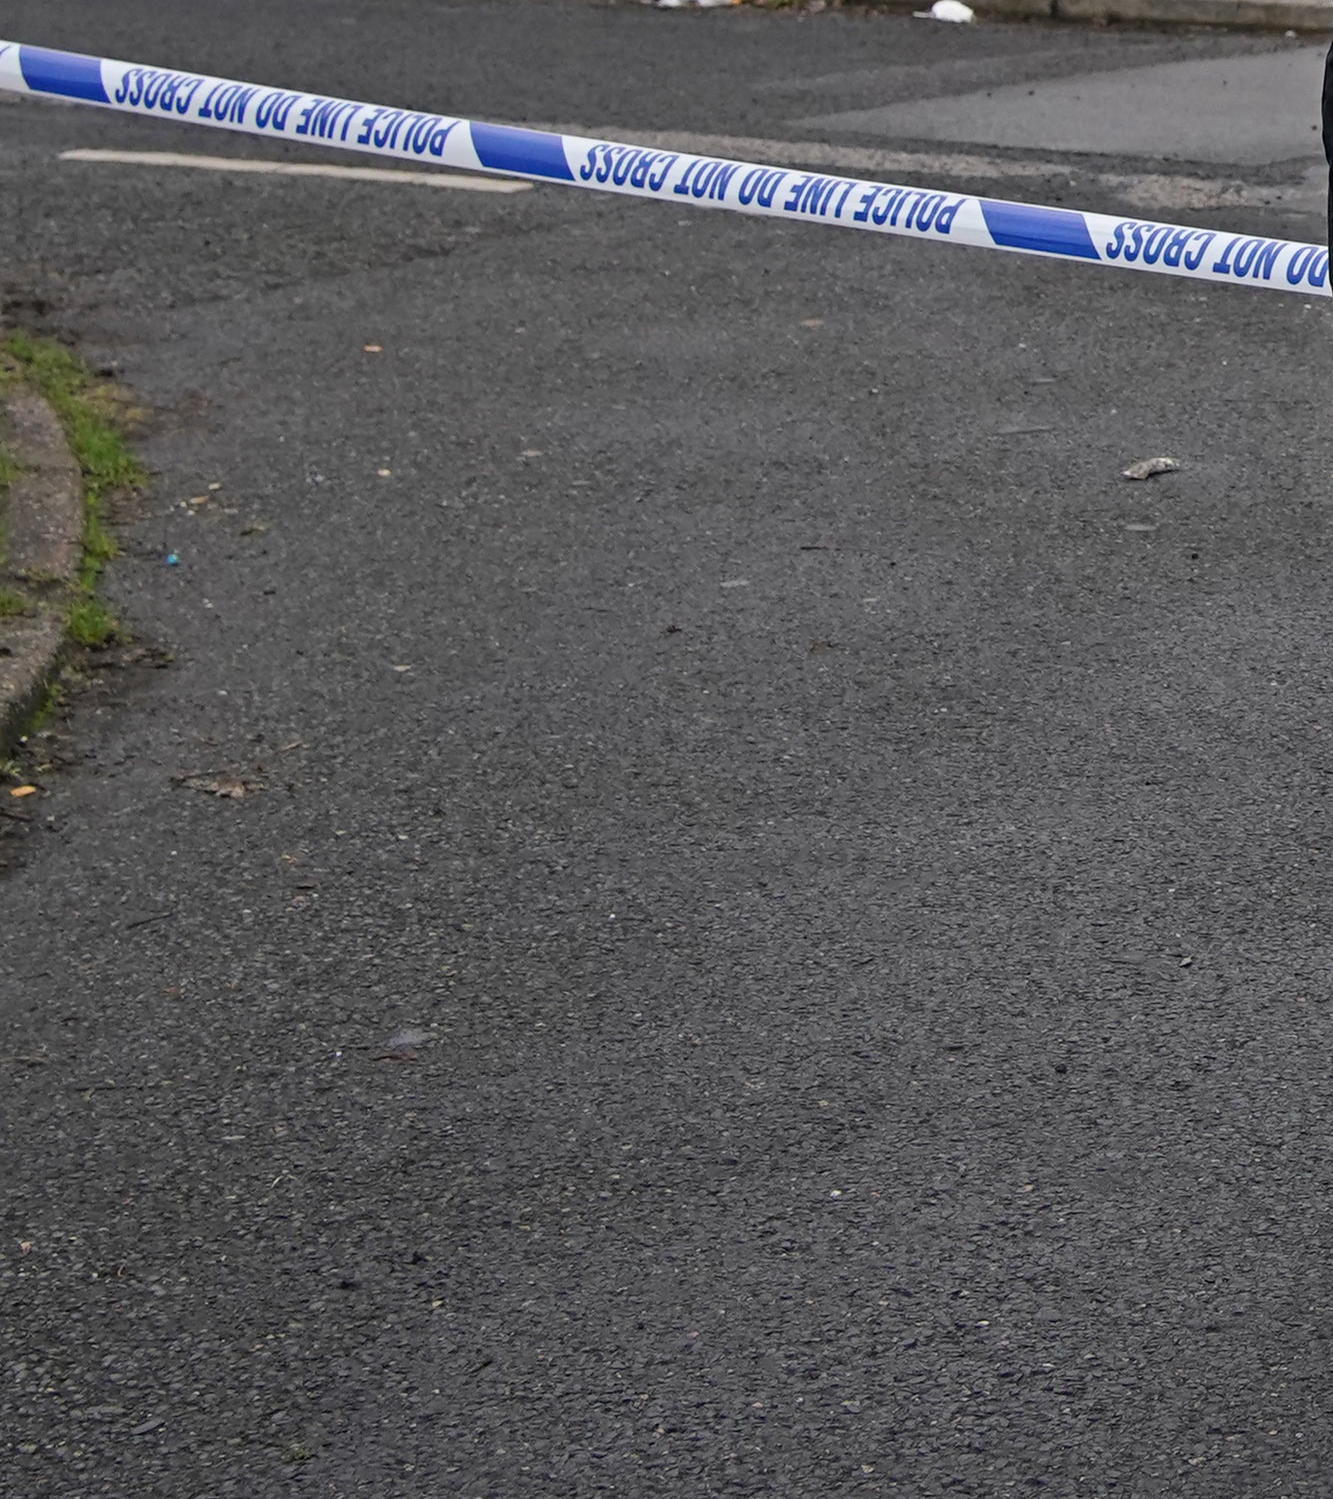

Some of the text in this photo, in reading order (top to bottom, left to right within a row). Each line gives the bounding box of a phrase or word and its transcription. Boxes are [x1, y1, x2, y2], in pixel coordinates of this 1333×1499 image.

[114, 68, 457, 158] POLICE LINE DO NOT CROSS
[579, 144, 966, 235] POLICE LINE DO NOT CROSS
[1105, 222, 1330, 288] DO NOT CROSS
